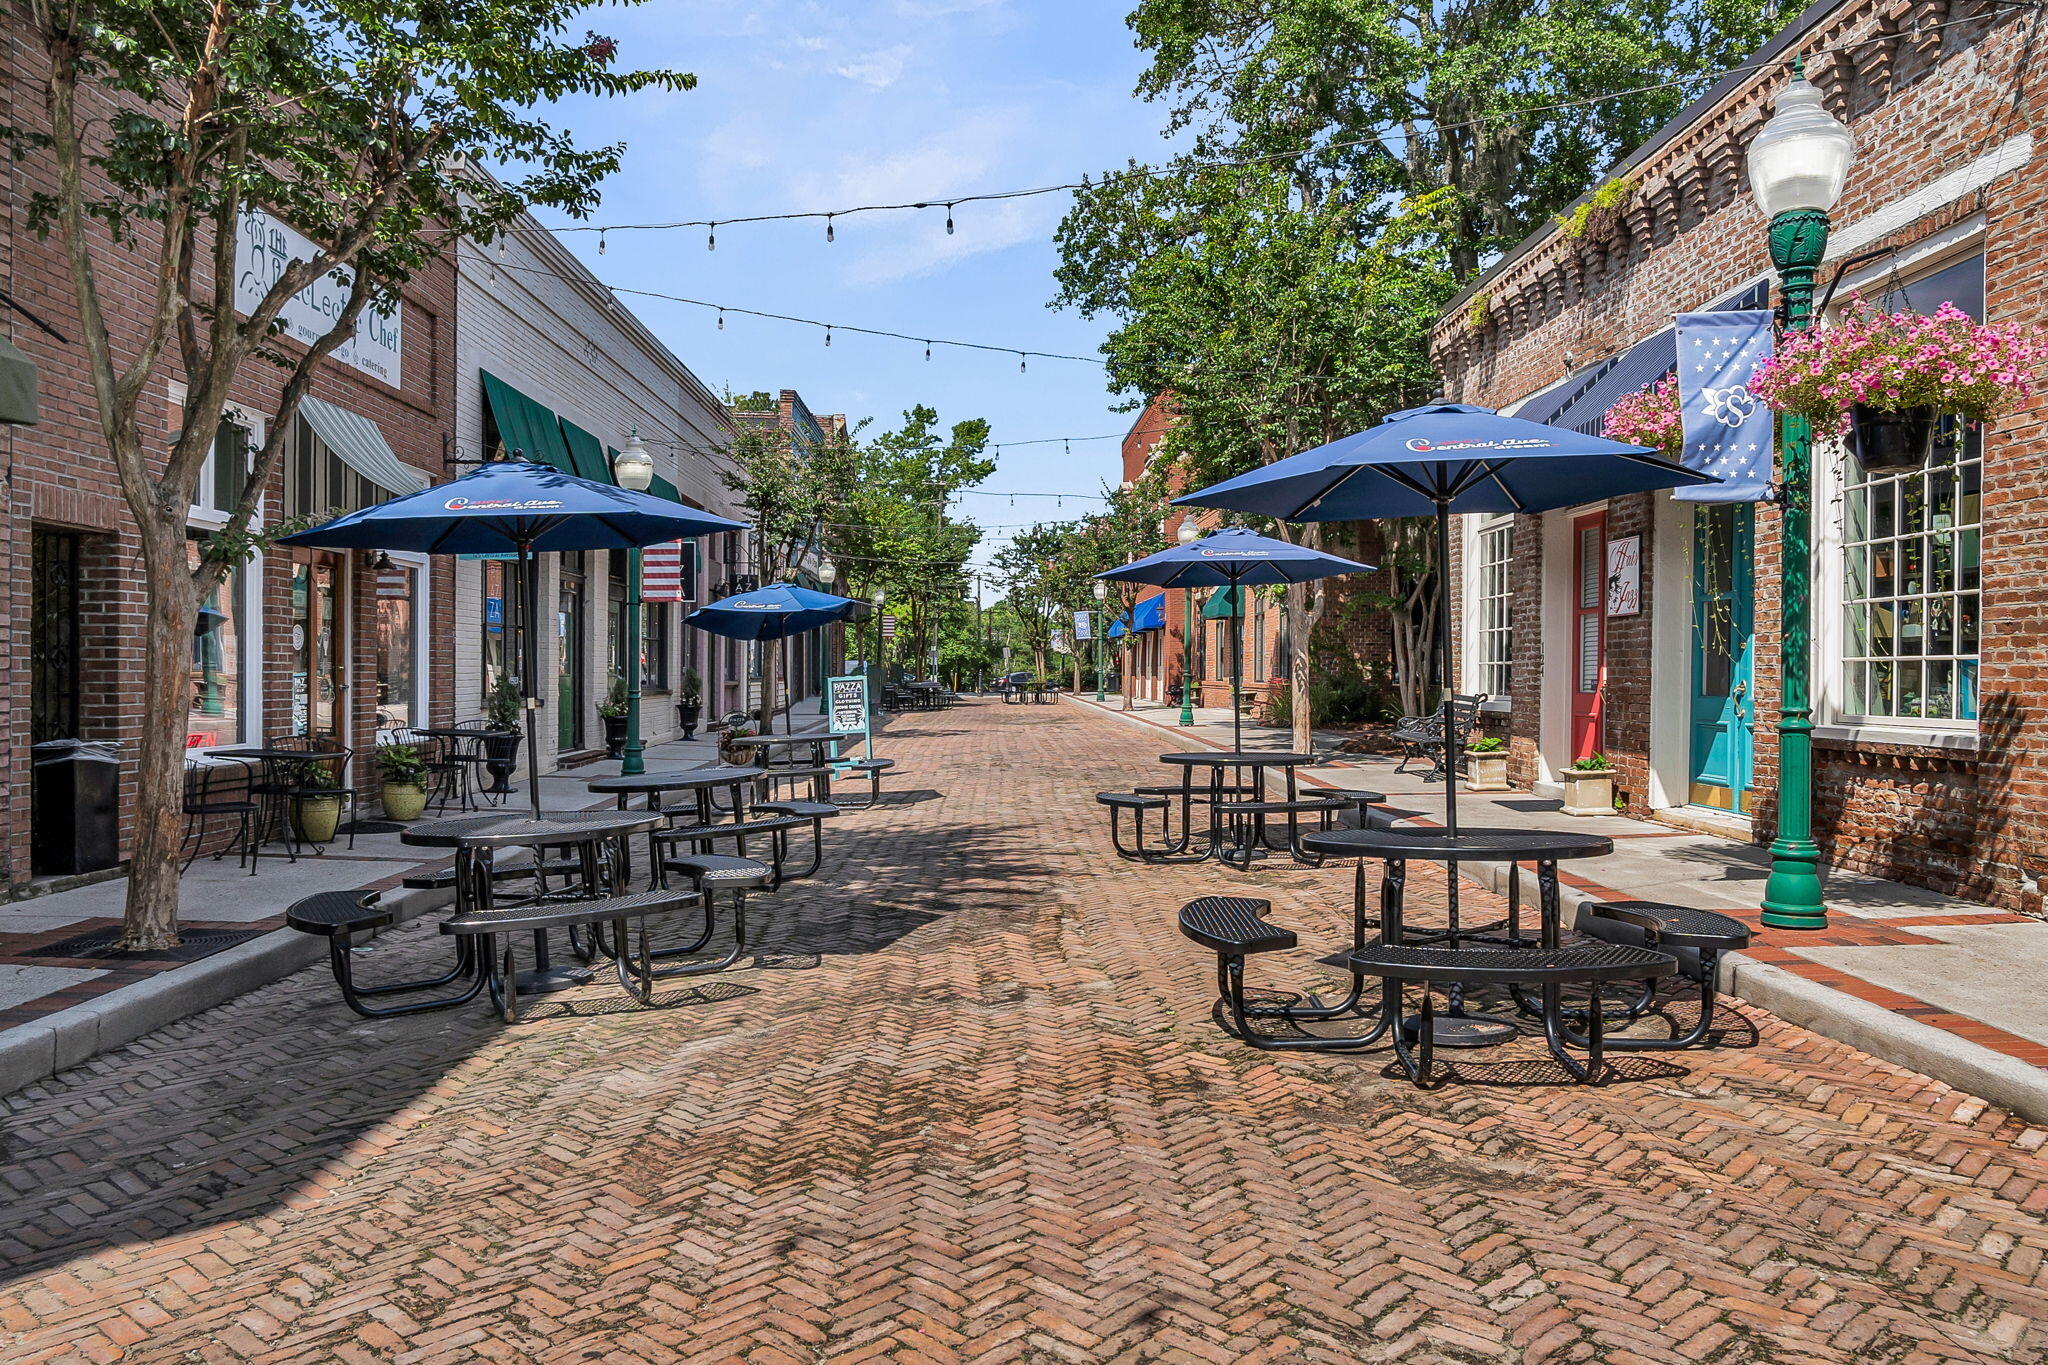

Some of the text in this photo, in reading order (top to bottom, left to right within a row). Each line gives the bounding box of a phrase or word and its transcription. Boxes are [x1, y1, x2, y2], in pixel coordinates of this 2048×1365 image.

[269, 228, 288, 256] THE
[368, 308, 399, 353] Chef
[361, 356, 389, 380] catering
[1405, 438, 1500, 452] Central
[444, 497, 521, 511] Central
